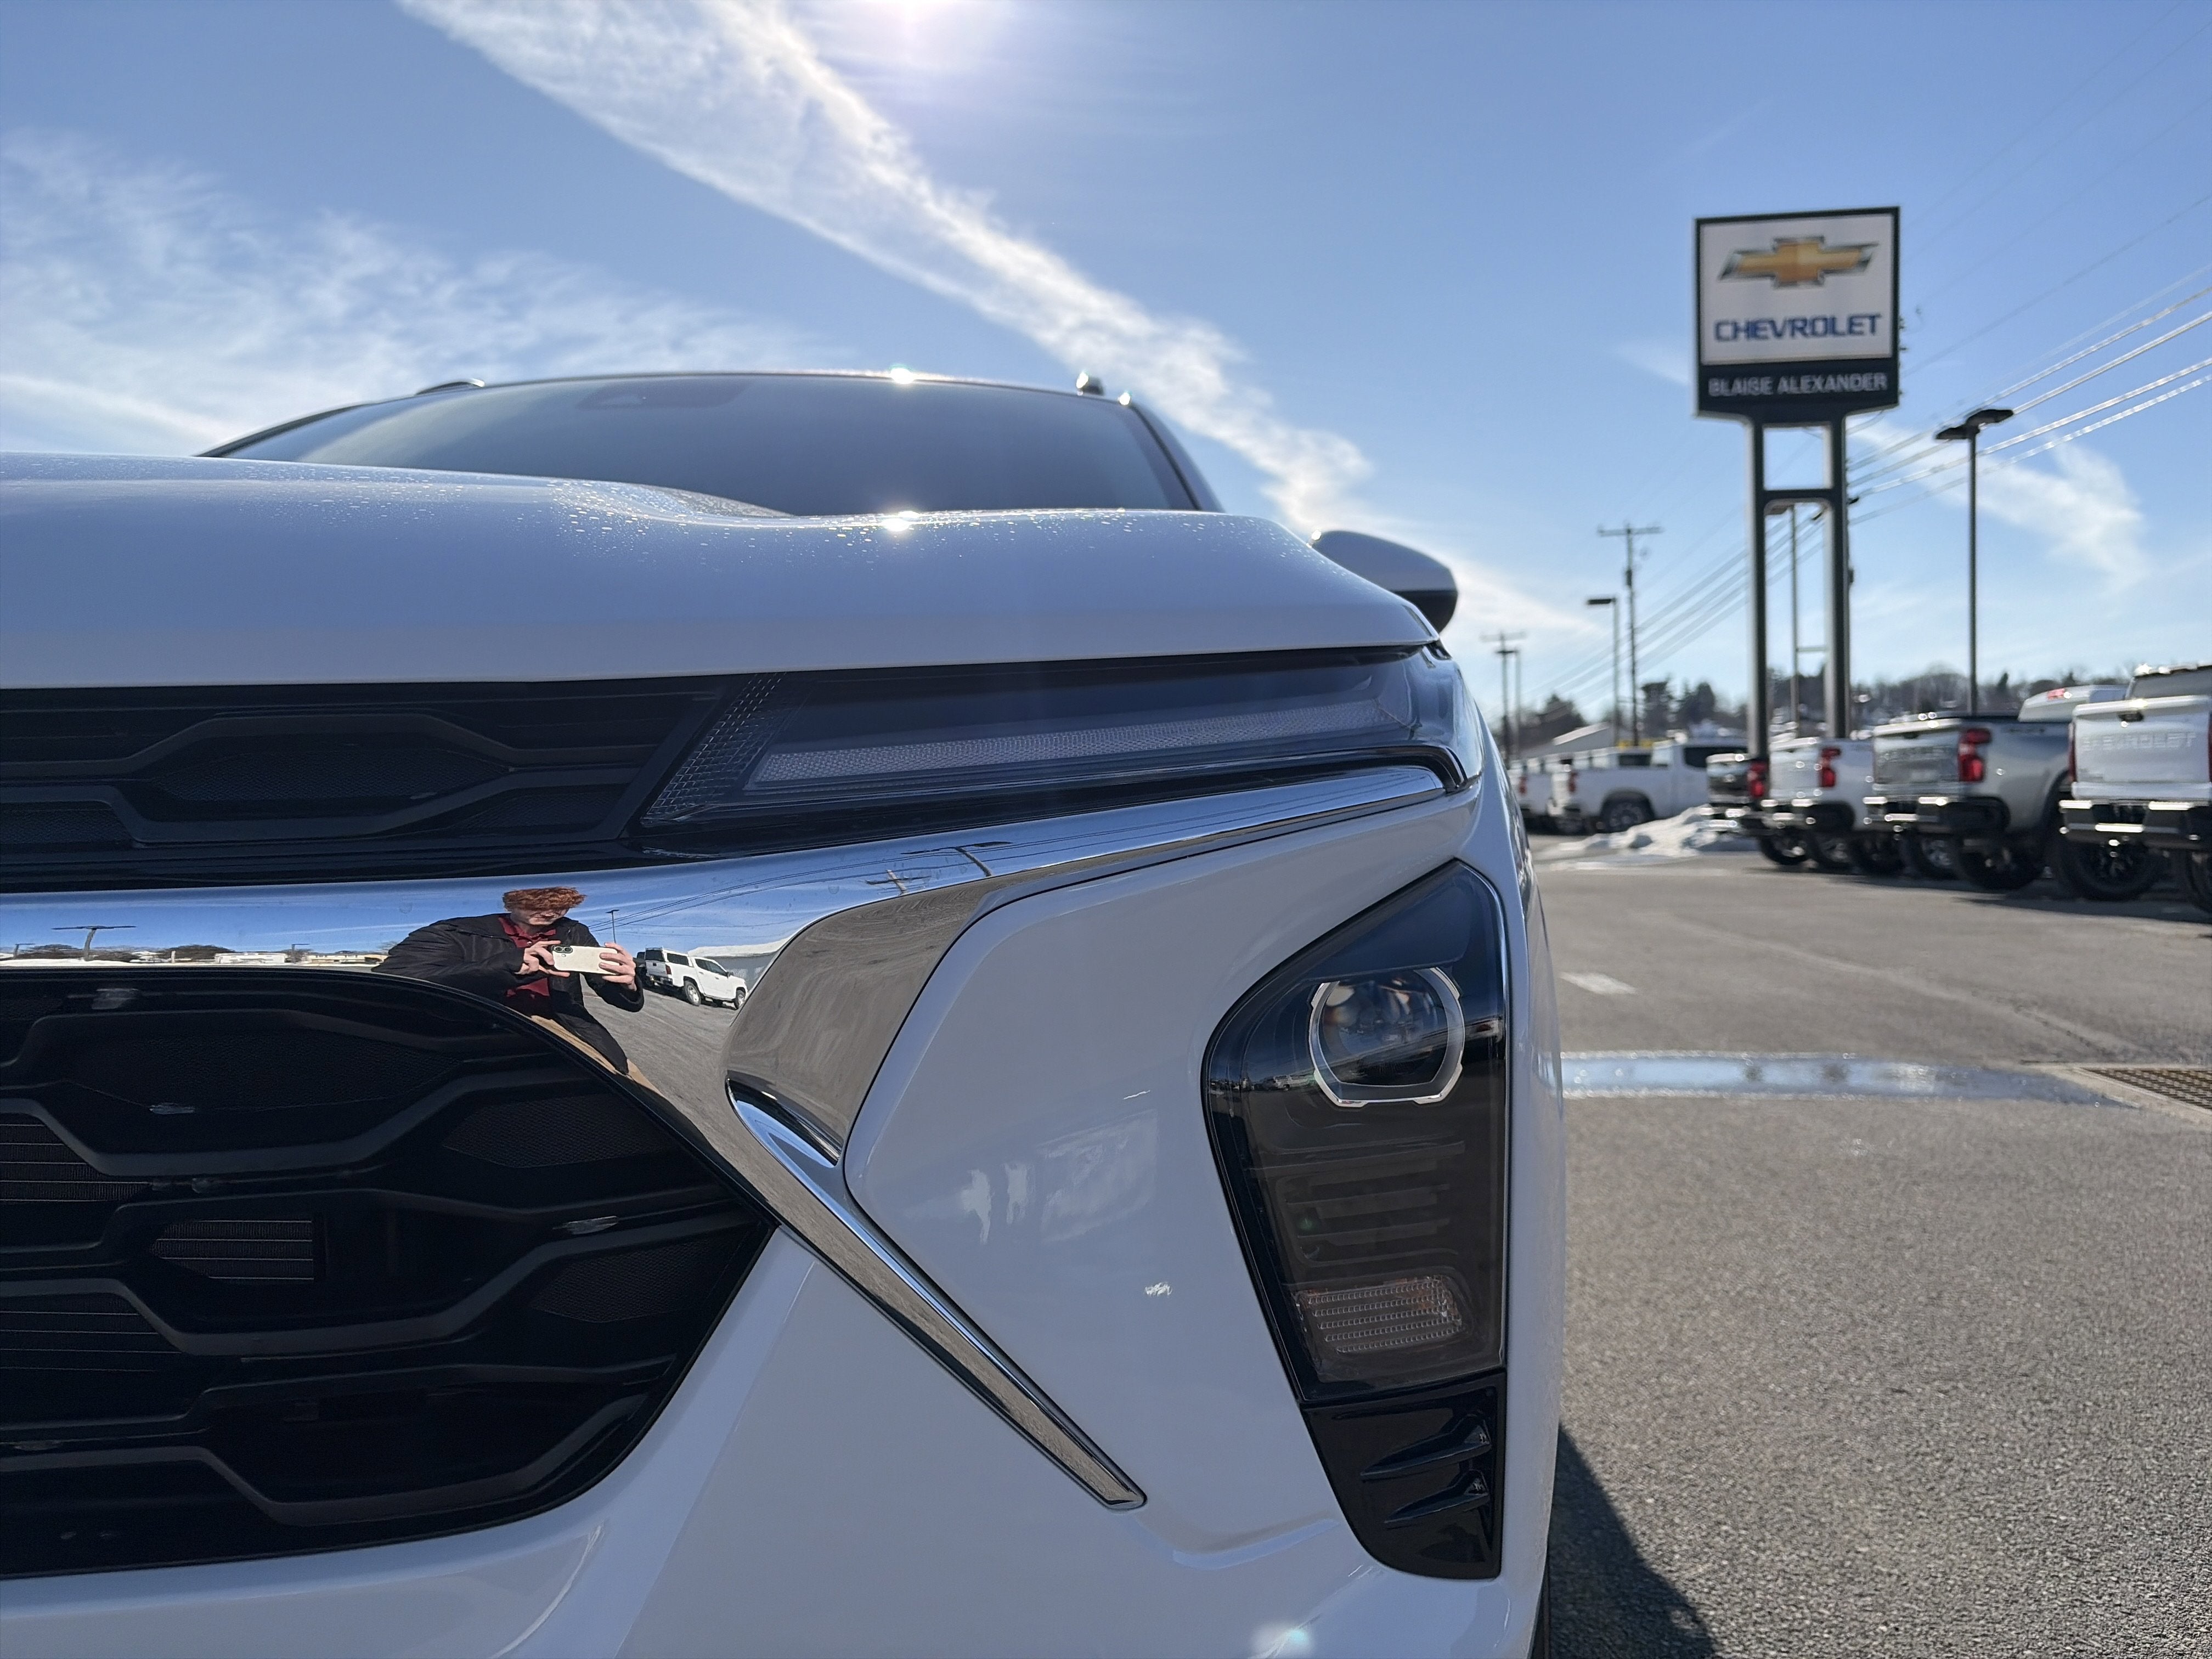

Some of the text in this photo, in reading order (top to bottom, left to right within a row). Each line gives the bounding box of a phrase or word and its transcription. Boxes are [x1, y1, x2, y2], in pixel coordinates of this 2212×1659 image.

[1714, 314, 1881, 341] CHEVROLET
[1708, 372, 1887, 397] BLAISE ALEXANDER
